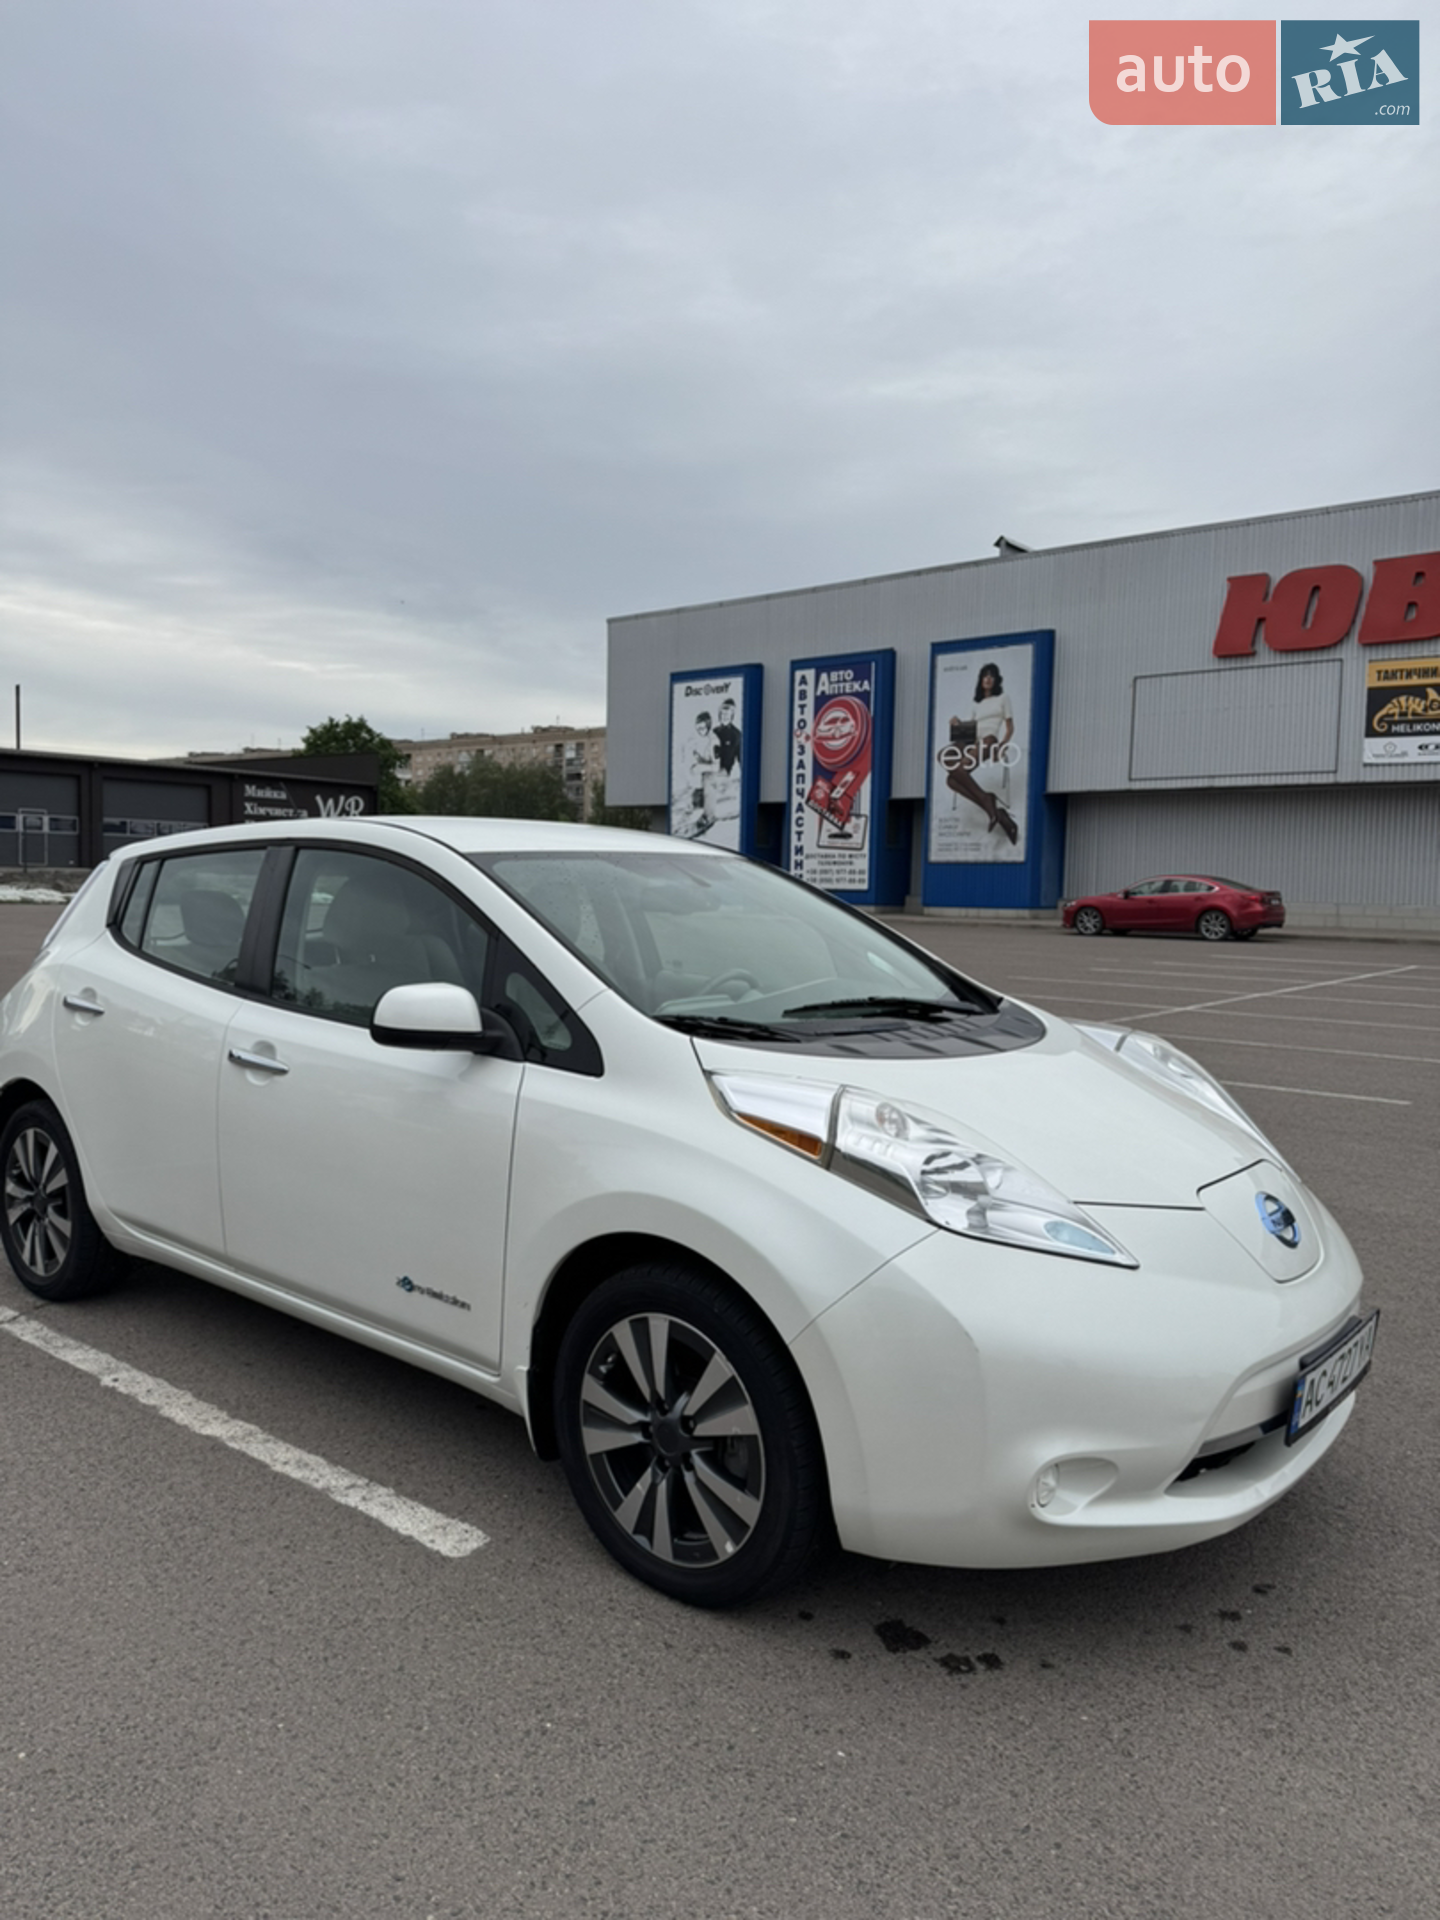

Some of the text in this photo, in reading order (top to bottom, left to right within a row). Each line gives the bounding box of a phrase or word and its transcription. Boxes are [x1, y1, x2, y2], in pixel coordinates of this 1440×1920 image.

[1213, 551, 1440, 658] ЮВ
[816, 673, 871, 696] АПТЕКА
[1391, 722, 1440, 733] HELIKON
[940, 738, 1021, 770] estro
[244, 784, 287, 799] Мийка
